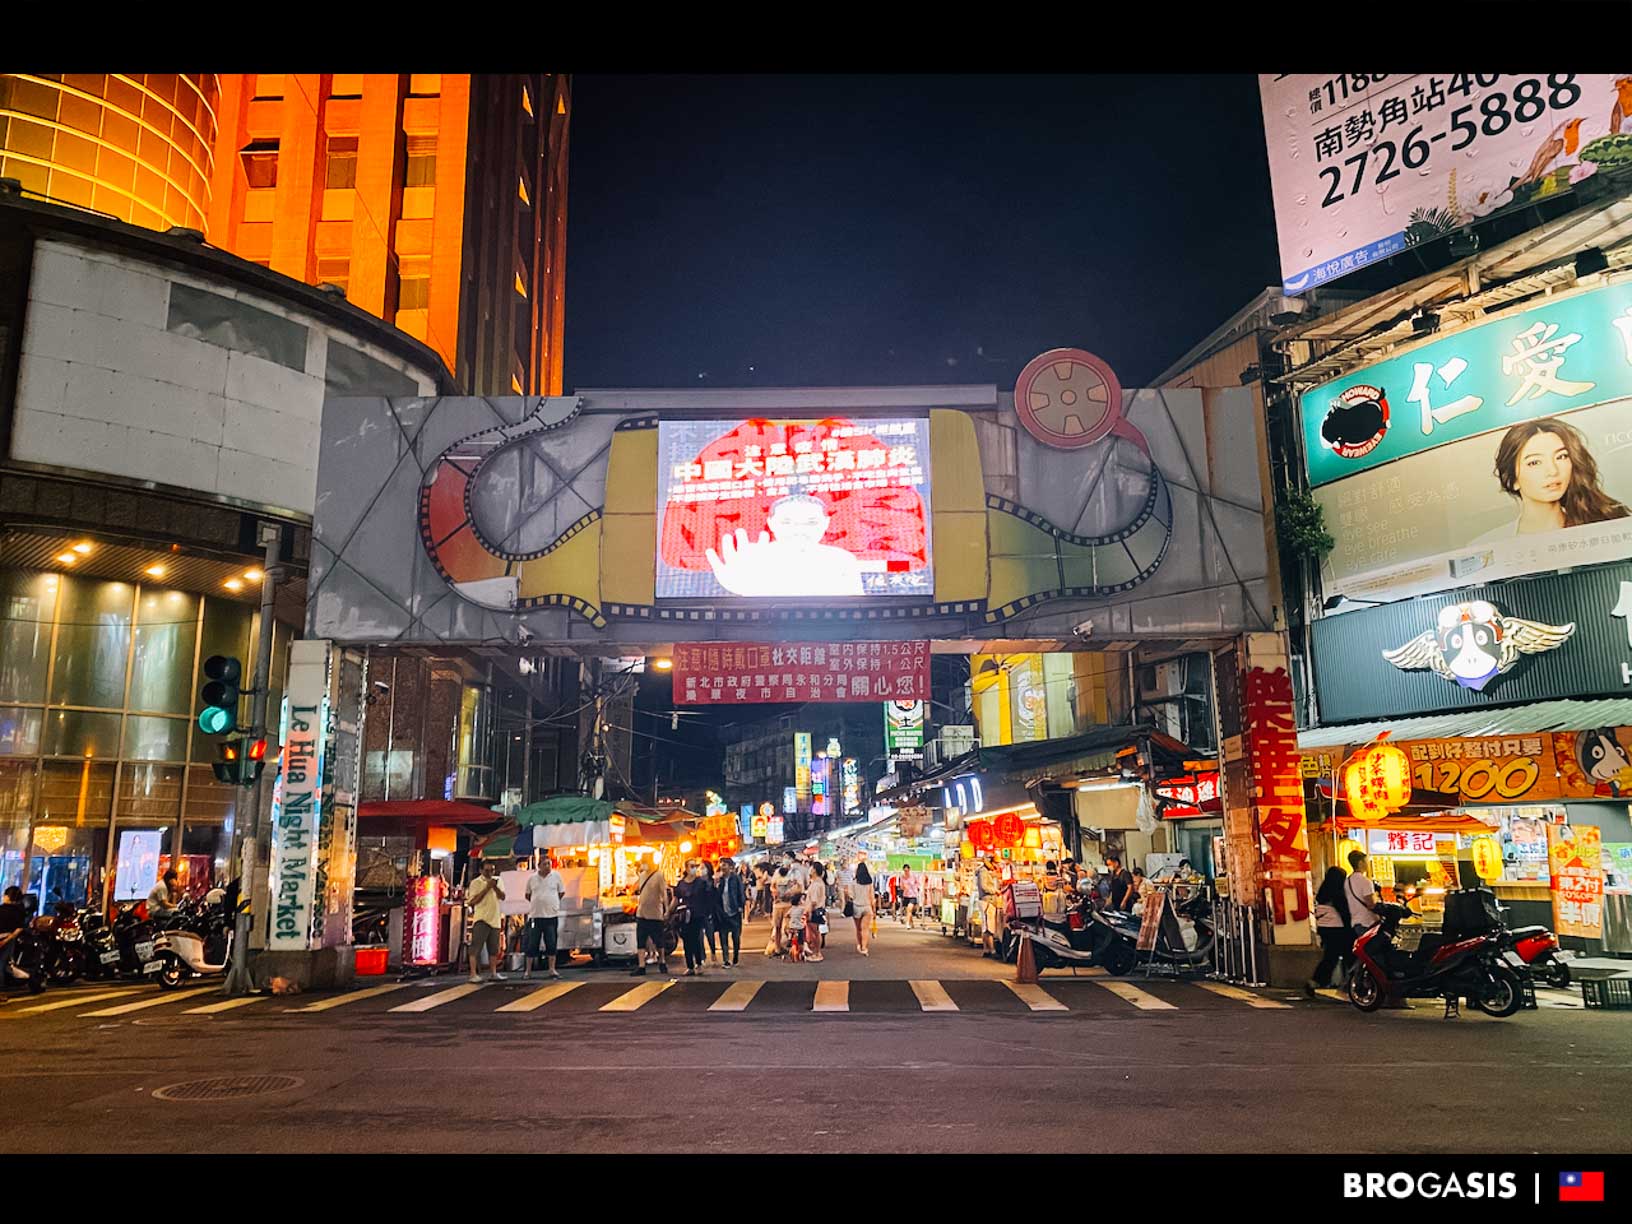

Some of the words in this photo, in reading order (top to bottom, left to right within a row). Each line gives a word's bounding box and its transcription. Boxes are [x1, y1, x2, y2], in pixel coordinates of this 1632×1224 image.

[1318, 74, 1582, 209] 2726-5888
[1312, 249, 1369, 281] 海悅廣告
[1406, 305, 1632, 435] 仁愛
[1341, 386, 1380, 401] HOWARD
[1341, 432, 1383, 458] EYEWEAR
[772, 646, 826, 666] 社交距離
[686, 673, 848, 688] 新北市政府警察局永和分局
[851, 674, 925, 698] 關心您!
[291, 704, 317, 732] Le
[286, 738, 316, 785] Hua
[1414, 757, 1540, 799] 1200
[1248, 666, 1312, 925] 樂華夜市
[277, 790, 313, 850] Night
[274, 857, 308, 940] Market
